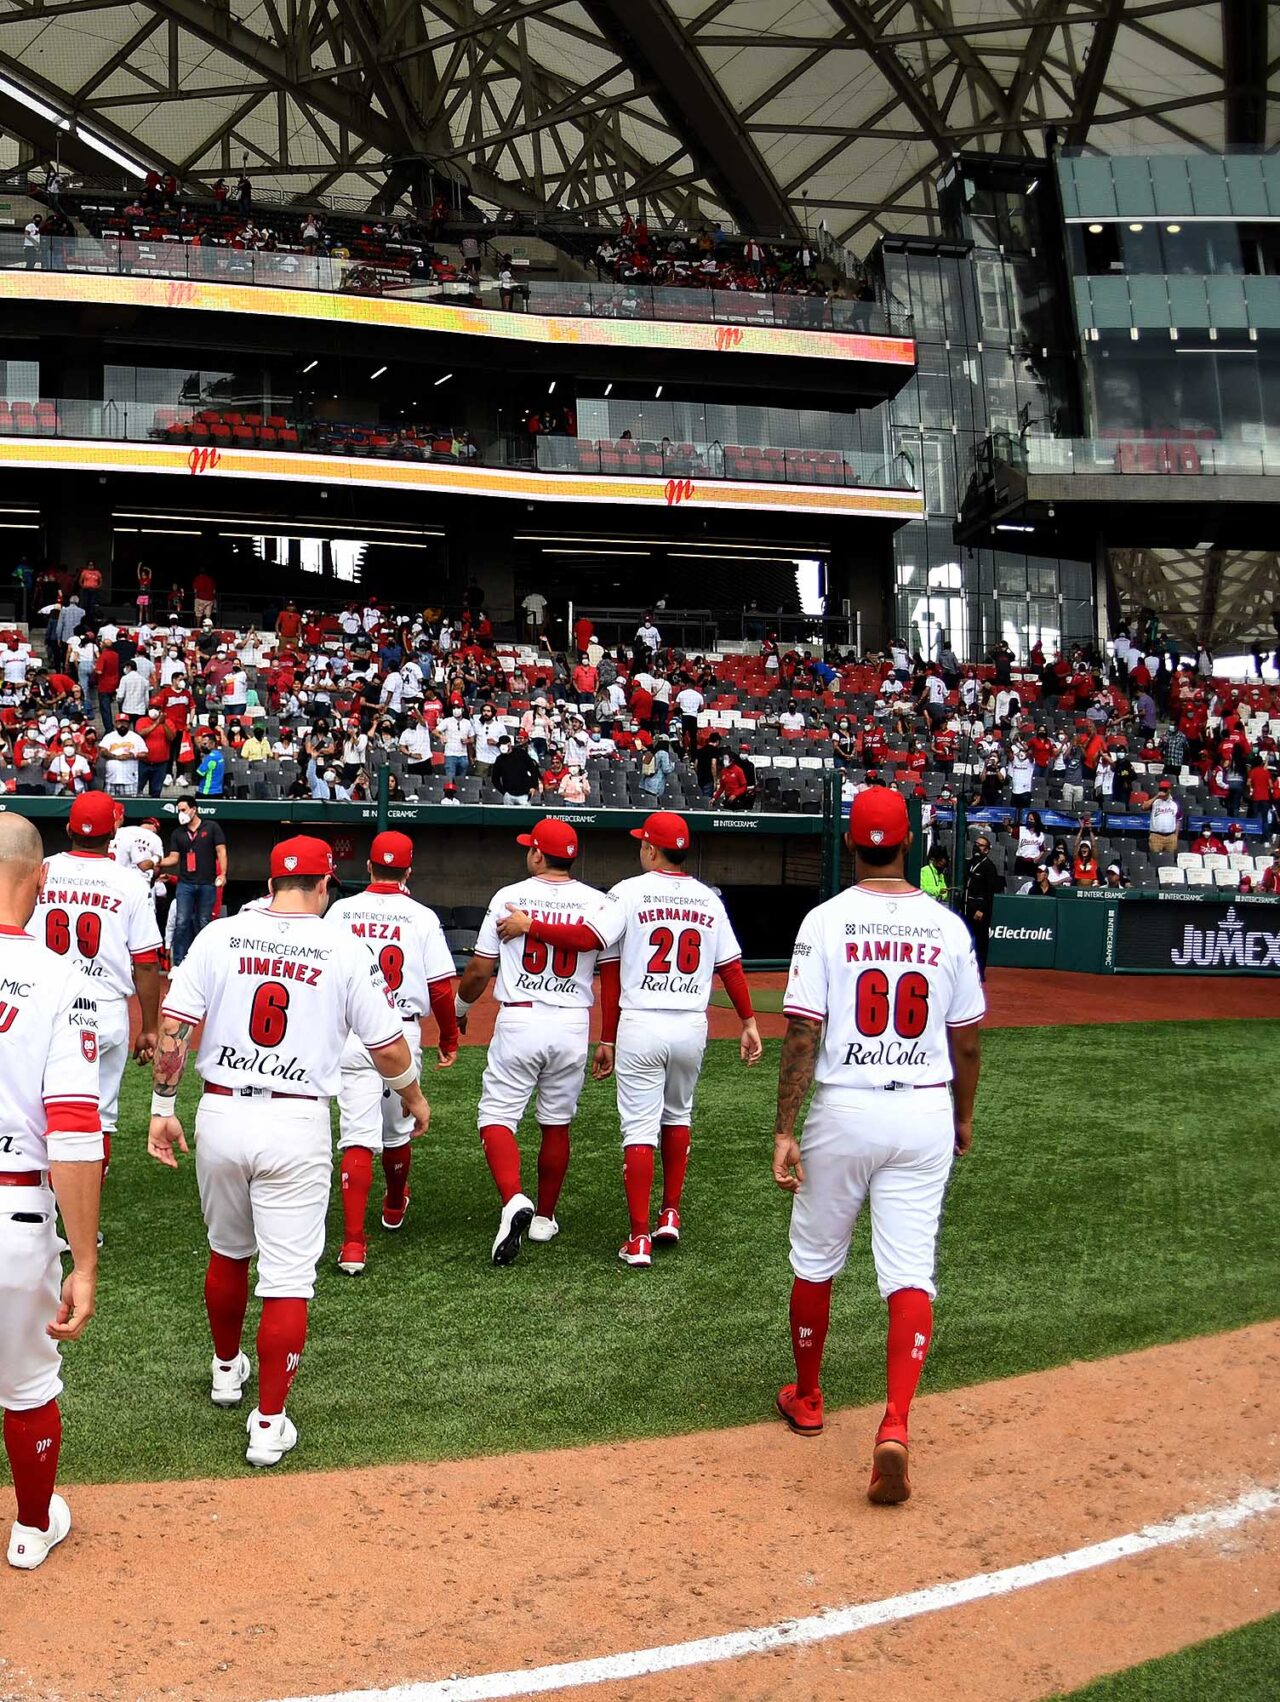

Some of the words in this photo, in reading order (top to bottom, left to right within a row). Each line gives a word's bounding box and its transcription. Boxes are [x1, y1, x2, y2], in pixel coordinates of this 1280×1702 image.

[36, 890, 122, 913] ERNANDEZ
[638, 908, 715, 929] HERNANDEZ
[46, 908, 101, 959] 69
[351, 923, 402, 941] MEZA
[858, 924, 938, 939] INTERCERAMIC
[994, 925, 1053, 941] Electrolit
[242, 938, 329, 961] INTERCERAMIC
[647, 926, 701, 974] 26
[845, 940, 941, 967] RAMIREZ
[238, 956, 322, 987] JIMÉNEZ
[249, 981, 290, 1048] 6
[855, 968, 929, 1039] 66
[17, 1545, 25, 1555] 8
